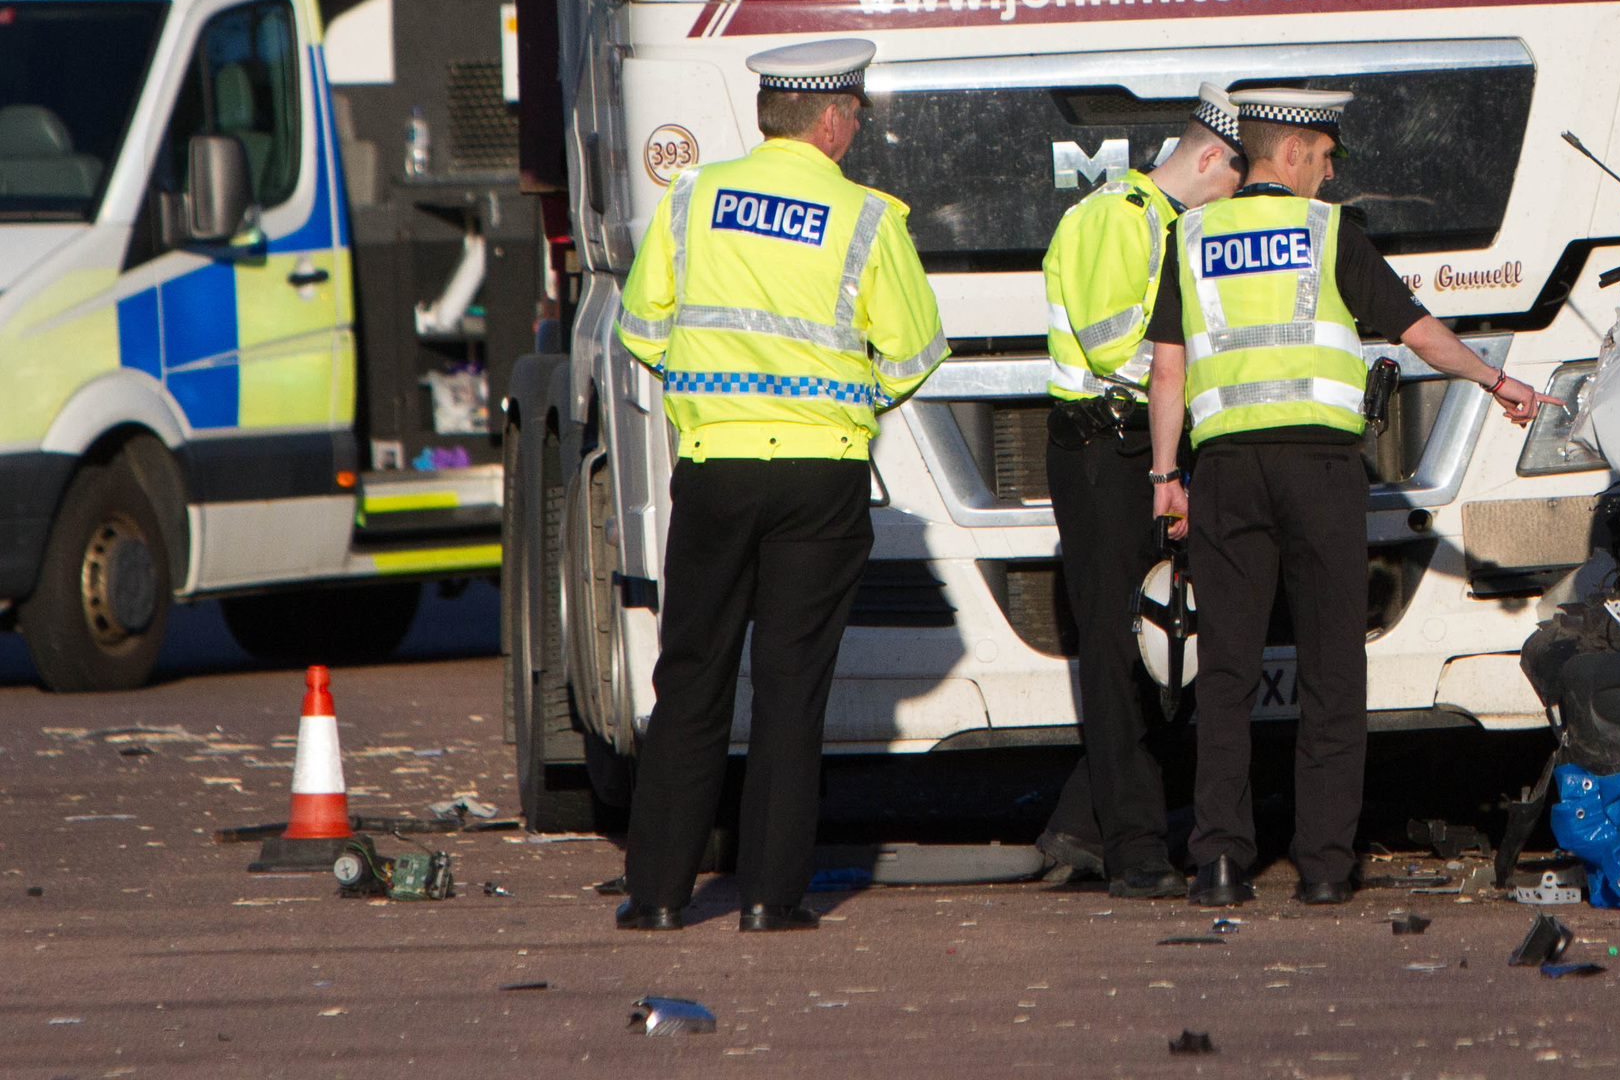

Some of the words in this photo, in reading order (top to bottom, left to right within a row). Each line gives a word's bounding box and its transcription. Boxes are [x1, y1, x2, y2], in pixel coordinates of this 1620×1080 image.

[650, 141, 692, 169] 393
[715, 194, 824, 240] POLICE
[1205, 233, 1310, 272] POLICE
[1435, 260, 1523, 292] Gunnell
